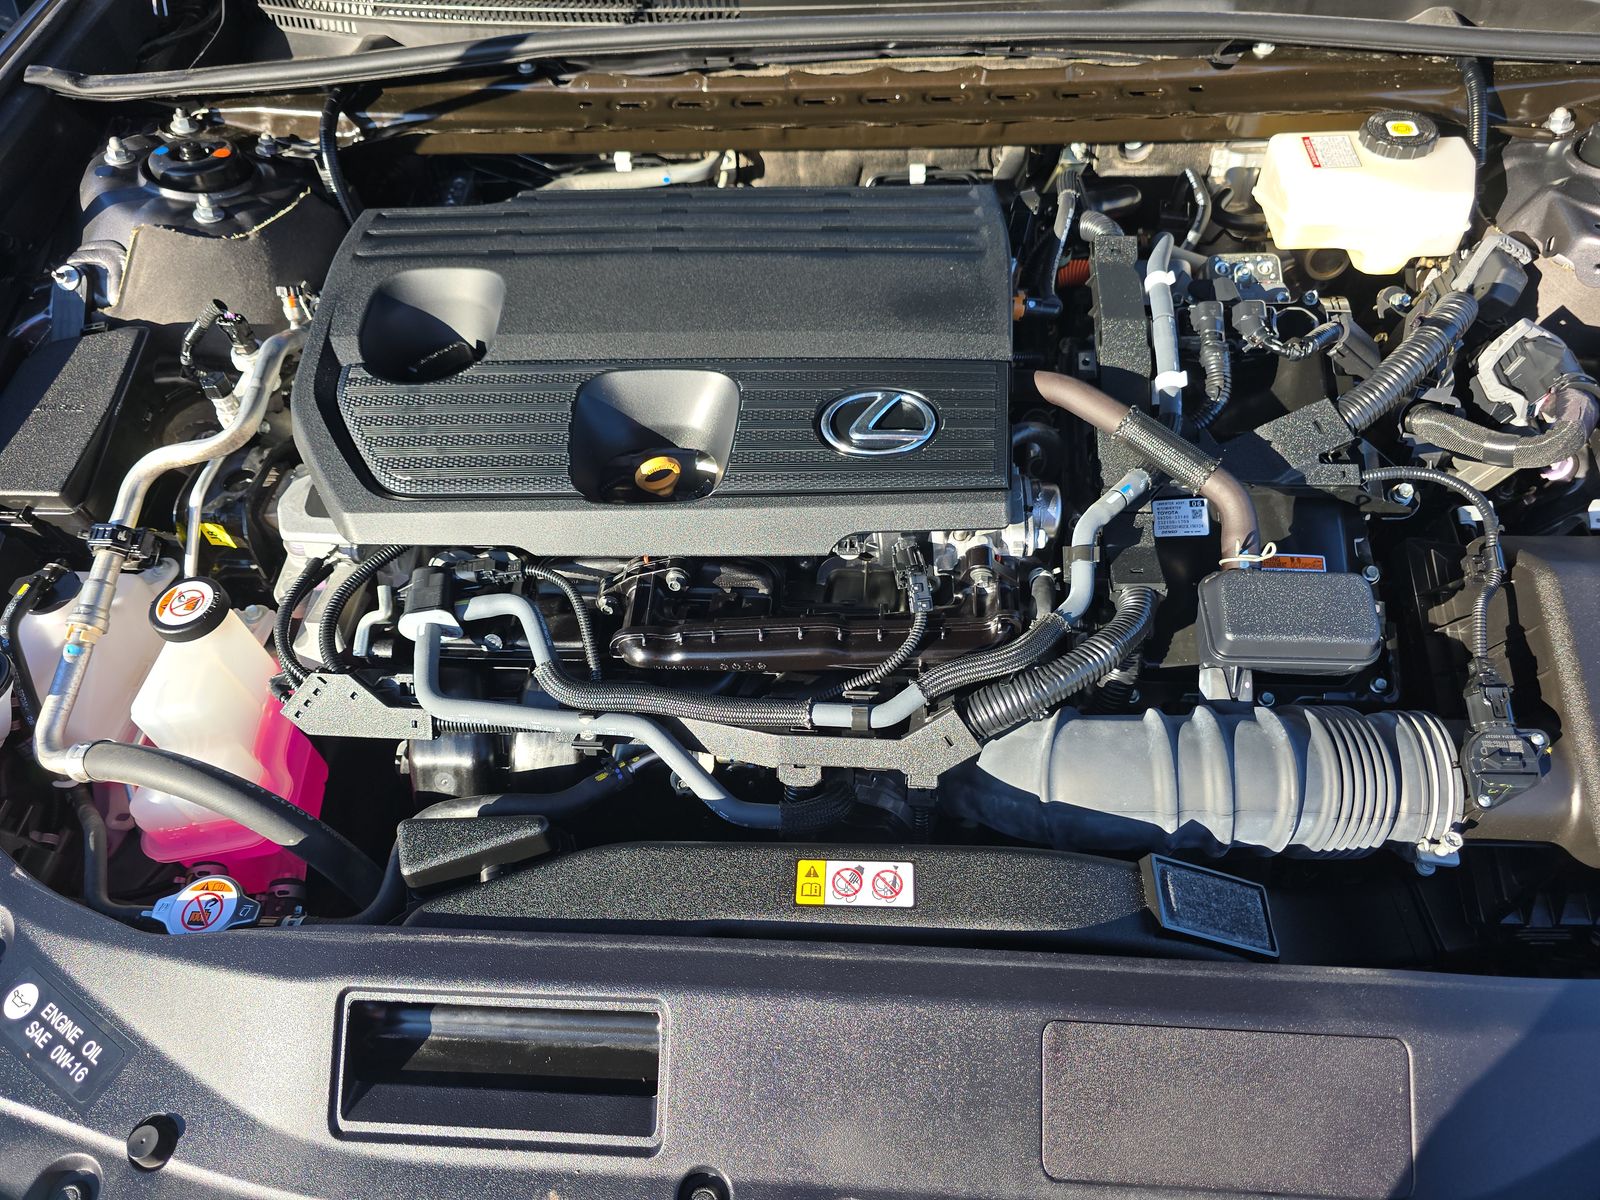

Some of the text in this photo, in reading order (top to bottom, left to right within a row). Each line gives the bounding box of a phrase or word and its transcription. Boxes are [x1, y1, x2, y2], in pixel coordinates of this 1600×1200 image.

[25, 1021, 89, 1082] SAE 0W-16
[40, 1002, 103, 1066] ENGINE OIL
